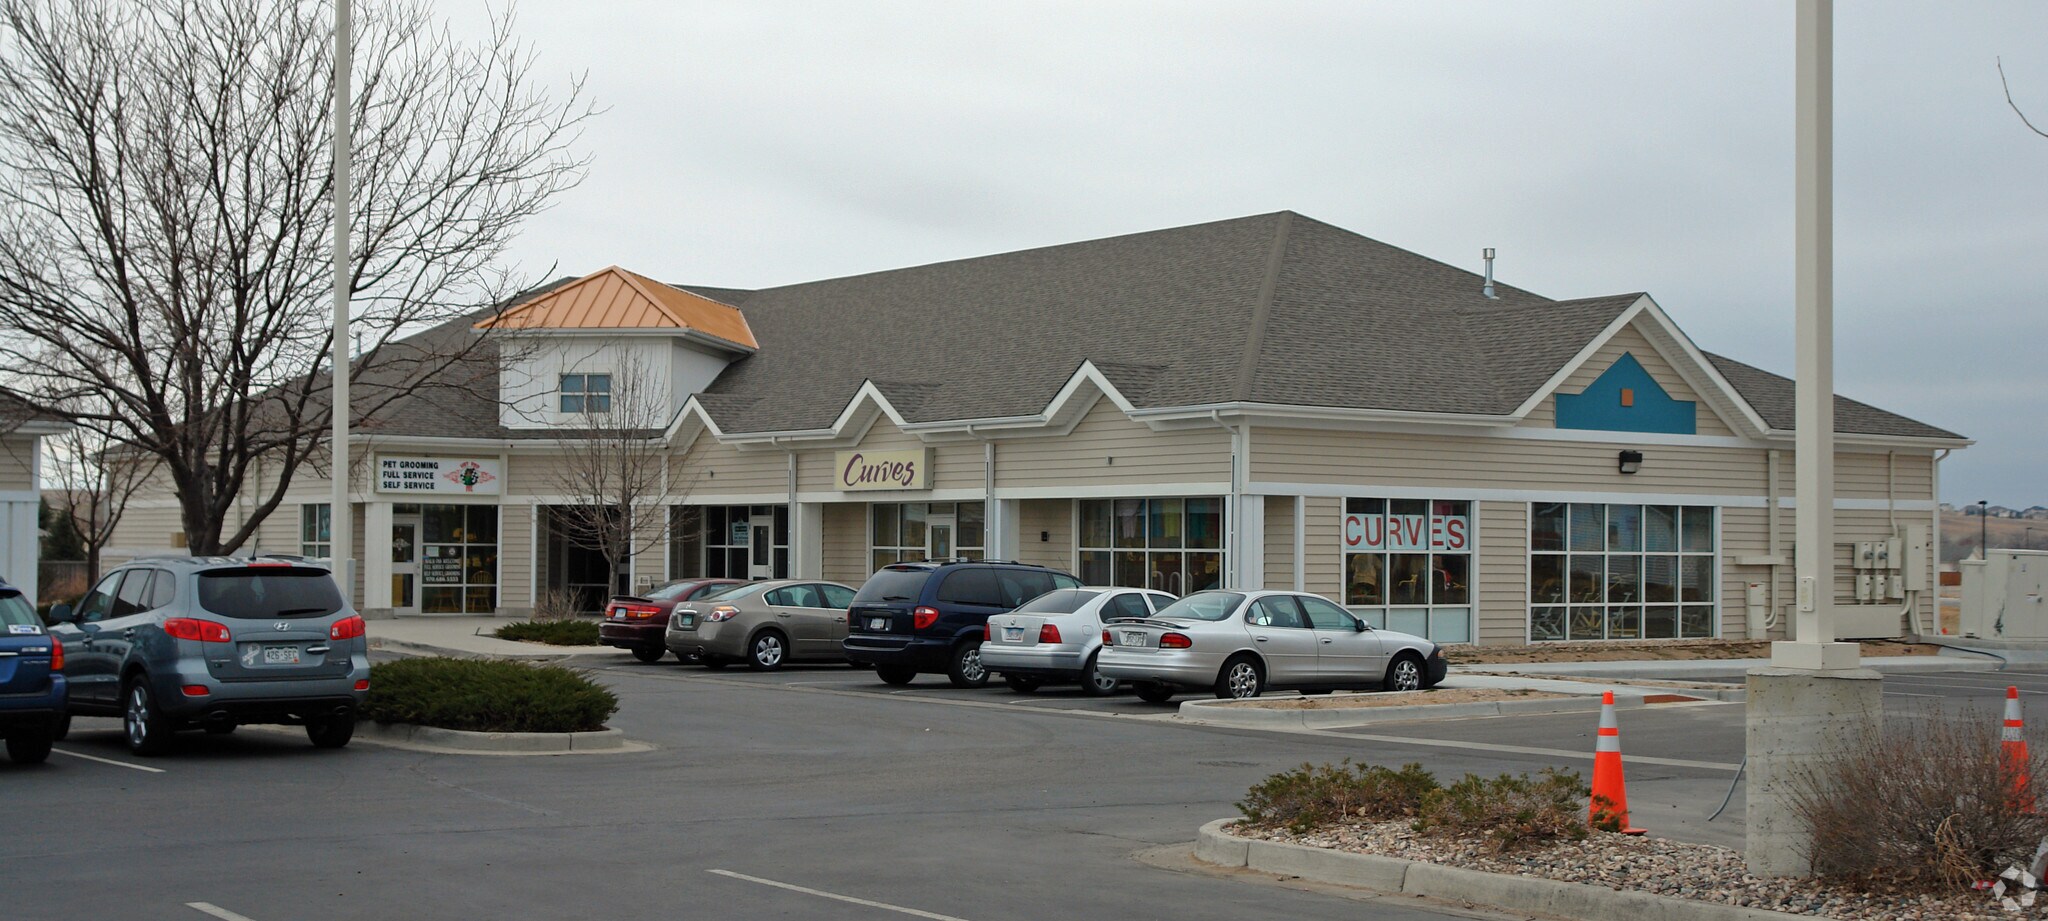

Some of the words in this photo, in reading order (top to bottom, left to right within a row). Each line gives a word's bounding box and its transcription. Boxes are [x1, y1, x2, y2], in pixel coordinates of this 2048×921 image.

[383, 460, 396, 468] PET
[400, 461, 438, 469] GROOMING
[843, 453, 915, 487] Curves
[403, 471, 434, 479] SERVICE
[404, 481, 434, 490] SERVICE
[1345, 515, 1465, 549] CURVES
